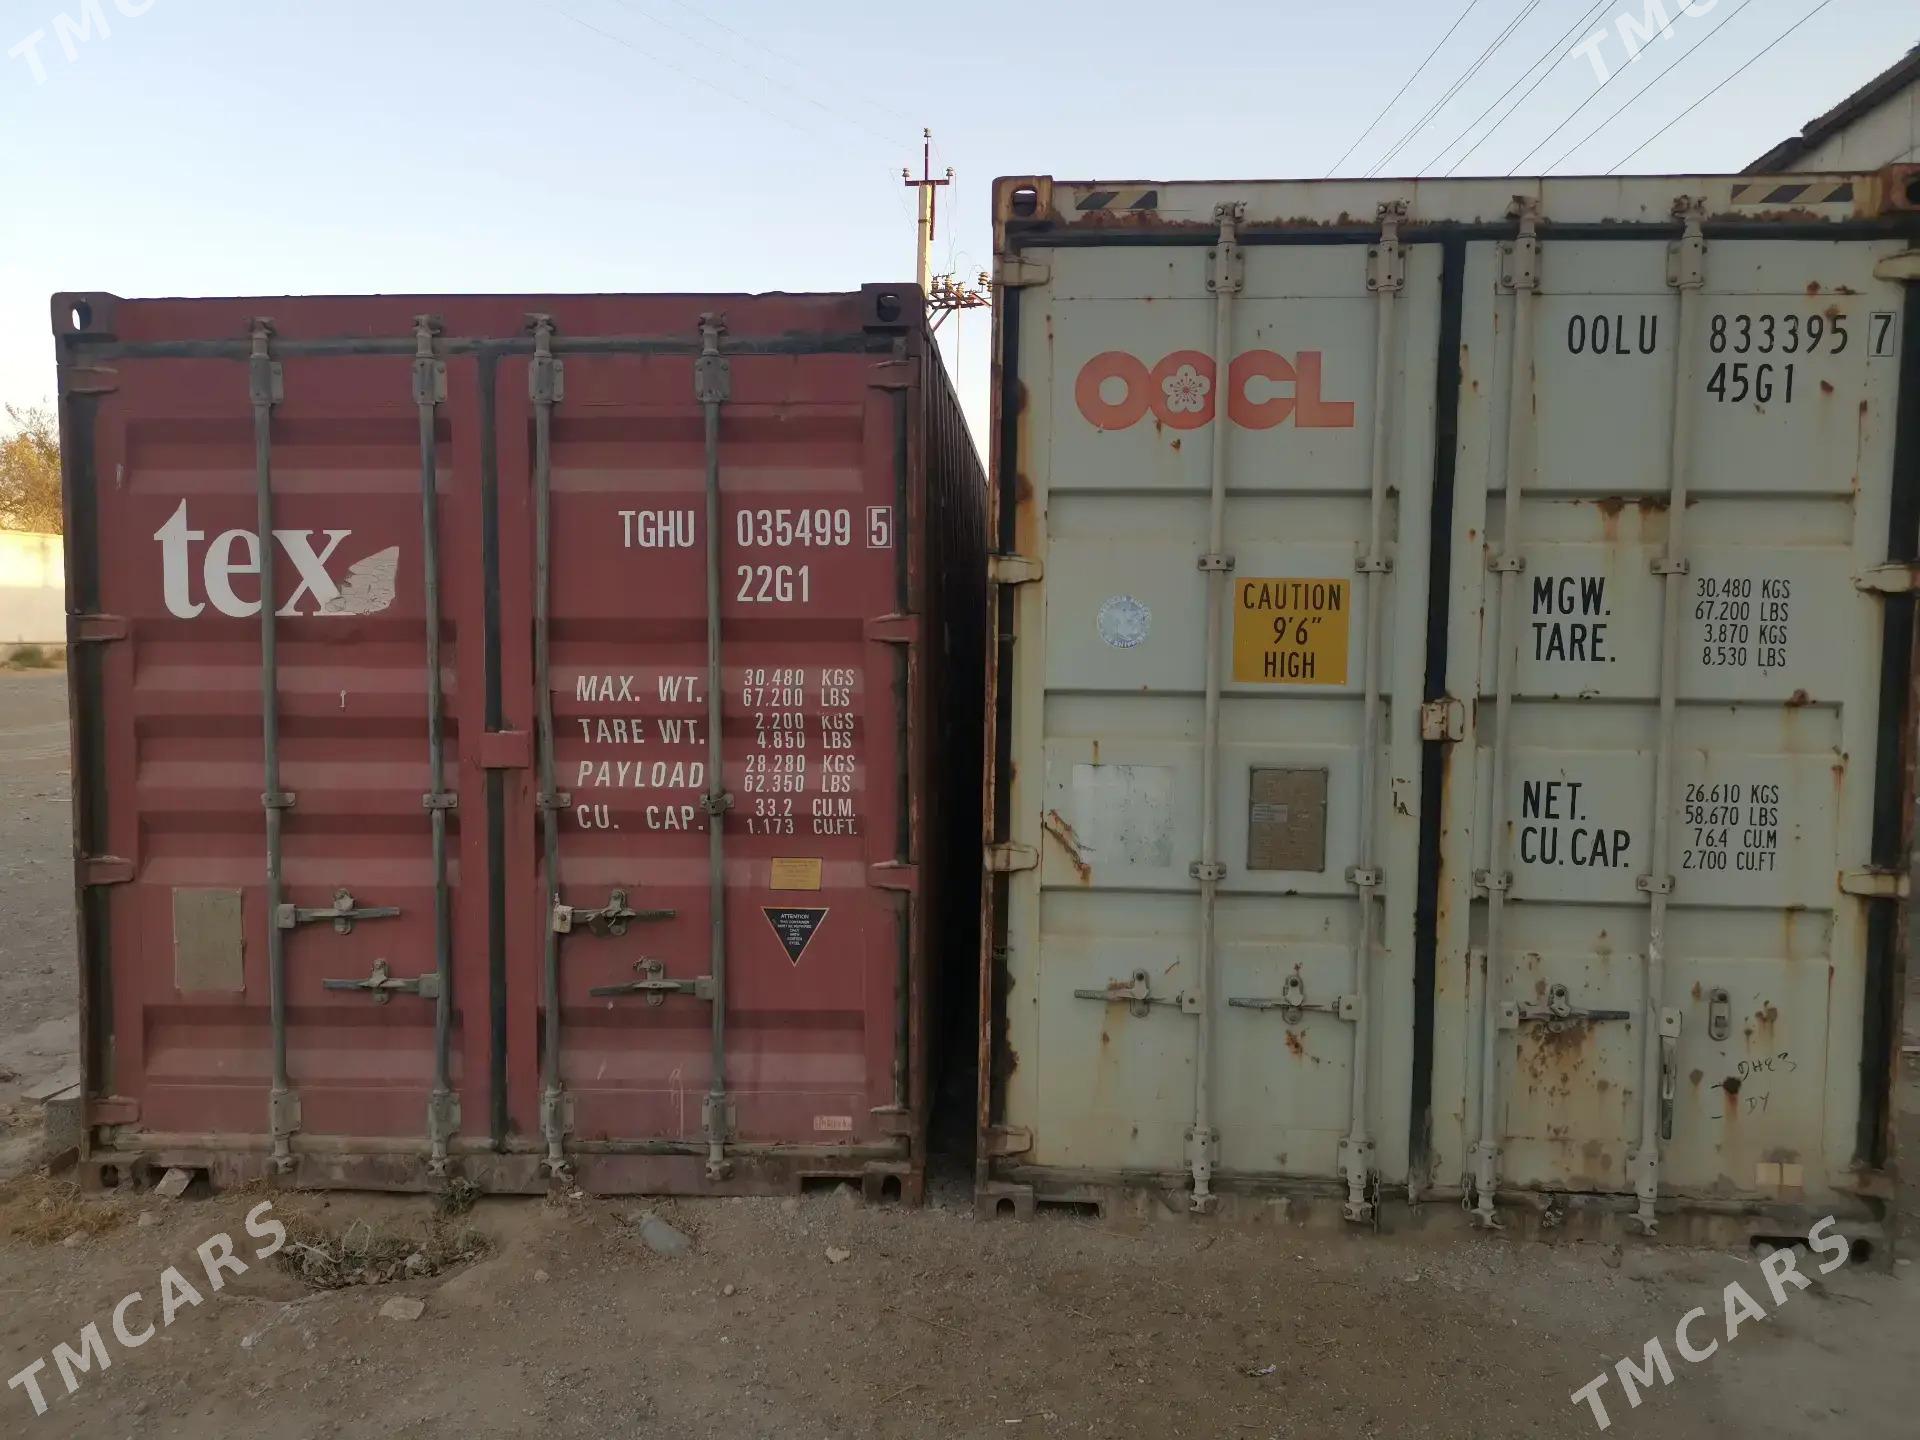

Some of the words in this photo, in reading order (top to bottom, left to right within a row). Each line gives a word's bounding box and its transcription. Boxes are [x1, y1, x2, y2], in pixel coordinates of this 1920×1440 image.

[1708, 313, 1848, 355] 833395
[1873, 314, 1893, 355] 7
[1075, 349, 1354, 430] OOCL
[1706, 362, 1794, 403] 45G1
[618, 509, 696, 547] TGHU
[736, 508, 851, 547] 035499
[870, 508, 888, 547] 5
[153, 497, 357, 619] tex
[736, 564, 810, 602] 22G1
[1531, 575, 1612, 616] MGW.
[1761, 578, 1791, 600] KGS
[1243, 582, 1342, 611] CAUTION
[1760, 602, 1789, 623] LBS
[1531, 622, 1616, 663] TARE.
[1759, 624, 1788, 645] KGS
[1263, 650, 1316, 680] HIGH
[1757, 647, 1786, 668] LBS
[576, 675, 641, 703] MAX.
[657, 675, 703, 704] WT.
[821, 669, 855, 687] KGS
[821, 688, 851, 708] LBS
[577, 718, 645, 744] TARE
[660, 718, 706, 746] WT.
[821, 712, 855, 731] KGS
[822, 731, 852, 750] LBS
[576, 760, 705, 788] PAYLOAD
[822, 755, 856, 774] KGS
[821, 774, 851, 793] LBS
[1750, 784, 1779, 805] KGS
[755, 798, 793, 818] 33.2
[812, 798, 857, 818] CU.M.
[1522, 780, 1587, 821] NET.
[576, 803, 620, 830] CU.
[645, 804, 705, 831] CAP.
[1750, 806, 1778, 827] LBS
[1694, 827, 1728, 848] 76.4
[1743, 829, 1777, 849] CU.M
[1736, 851, 1776, 871] CU.FT
